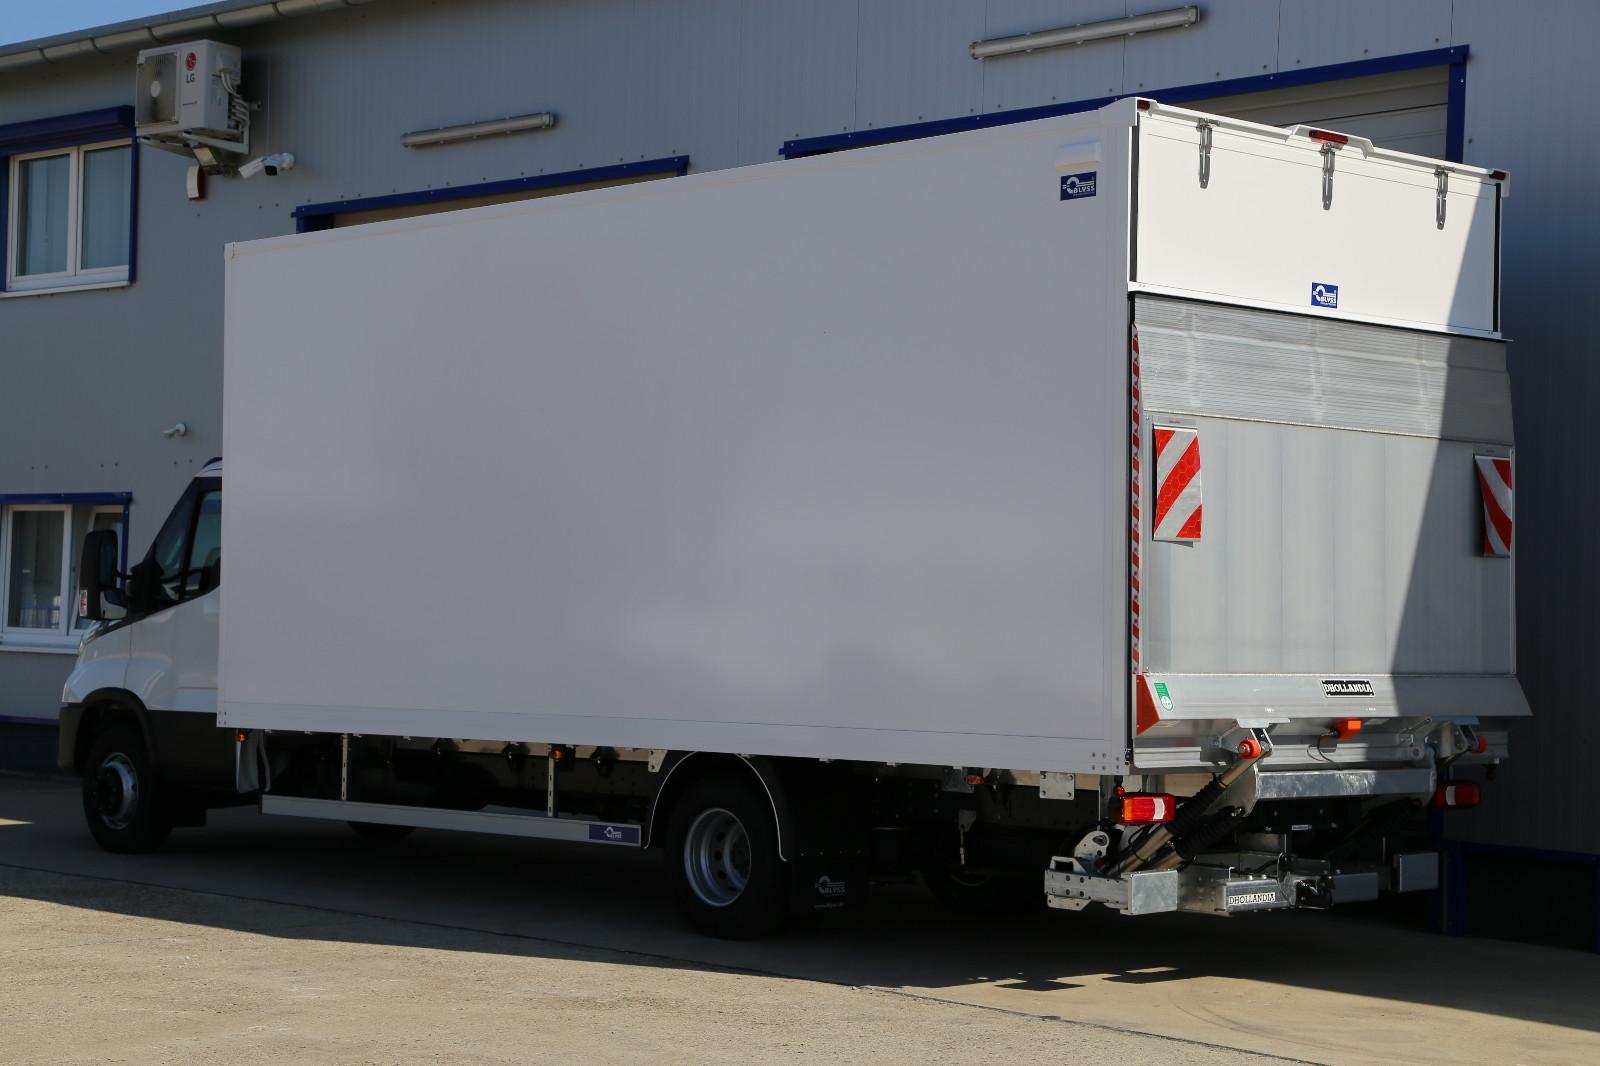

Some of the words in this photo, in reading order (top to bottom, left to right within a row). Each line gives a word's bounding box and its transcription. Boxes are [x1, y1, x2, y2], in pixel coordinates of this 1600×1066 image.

[186, 73, 196, 84] LG
[1073, 184, 1095, 194] BLYSS
[1323, 683, 1373, 693] DHOLLANDIA
